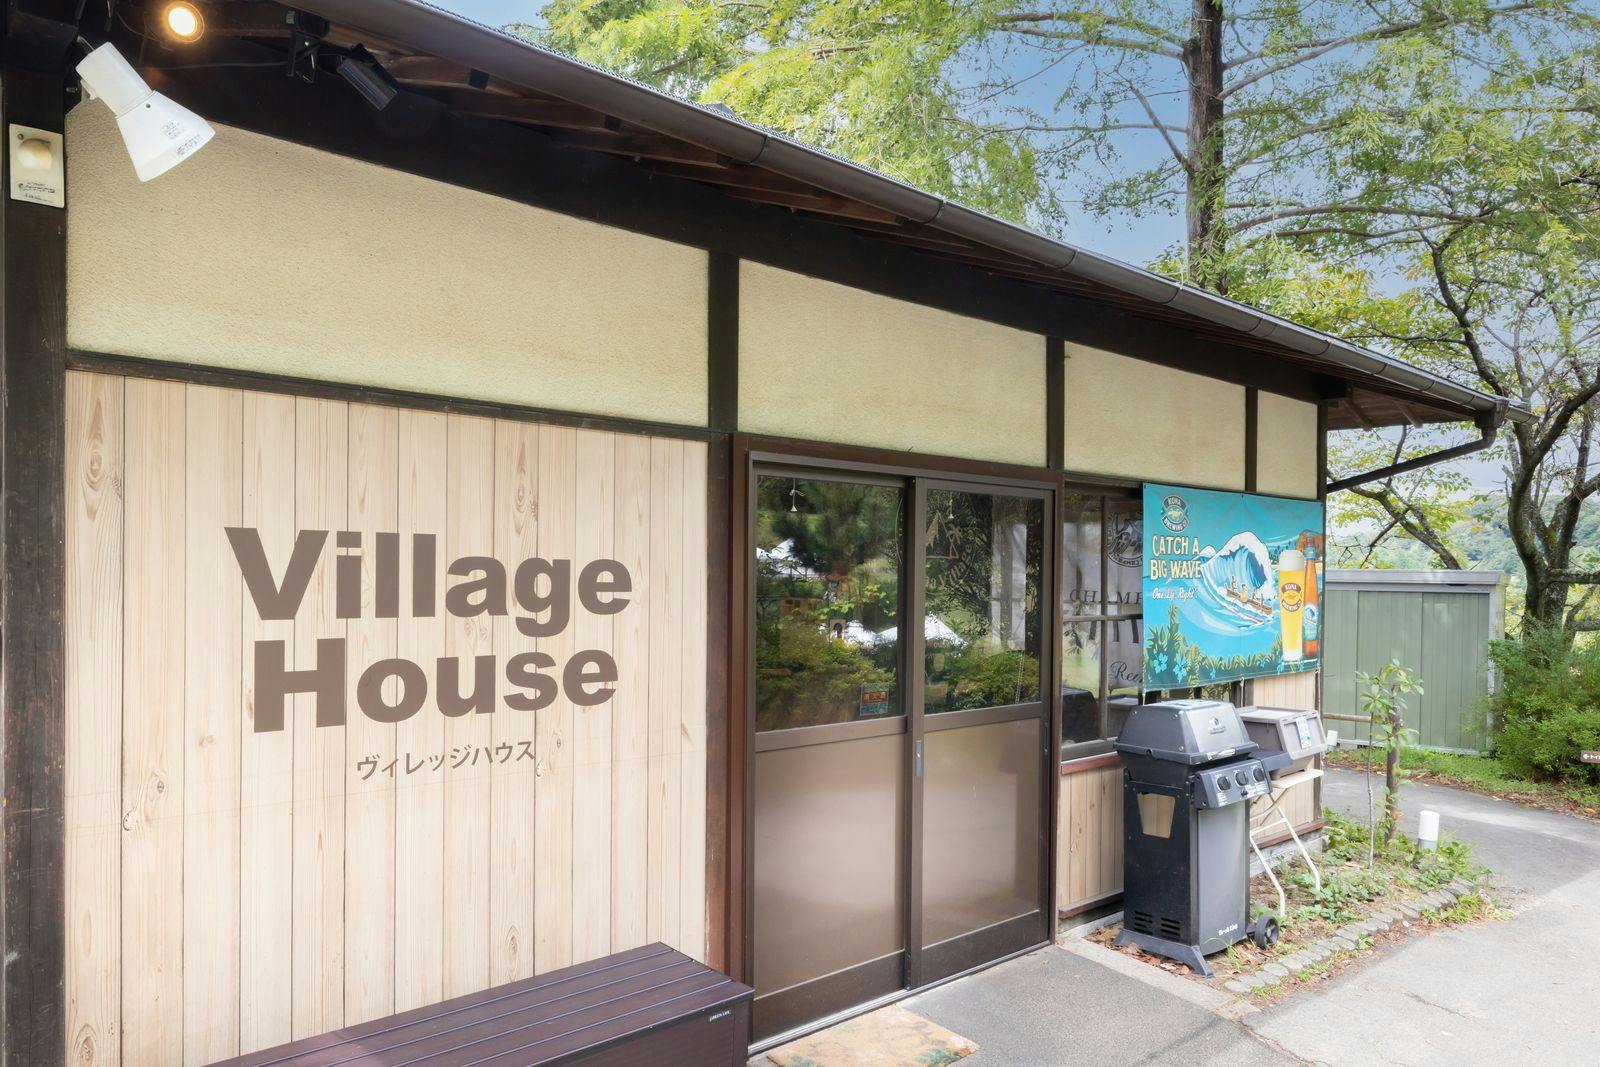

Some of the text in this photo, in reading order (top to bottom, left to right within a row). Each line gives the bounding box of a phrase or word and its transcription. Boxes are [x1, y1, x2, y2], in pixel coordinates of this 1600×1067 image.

[1152, 536, 1200, 557] CATCH A
[224, 527, 632, 638] Village
[1150, 559, 1202, 580] BIG WAVE
[254, 638, 619, 733] House
[357, 741, 536, 781] ヴィレッジハウス
